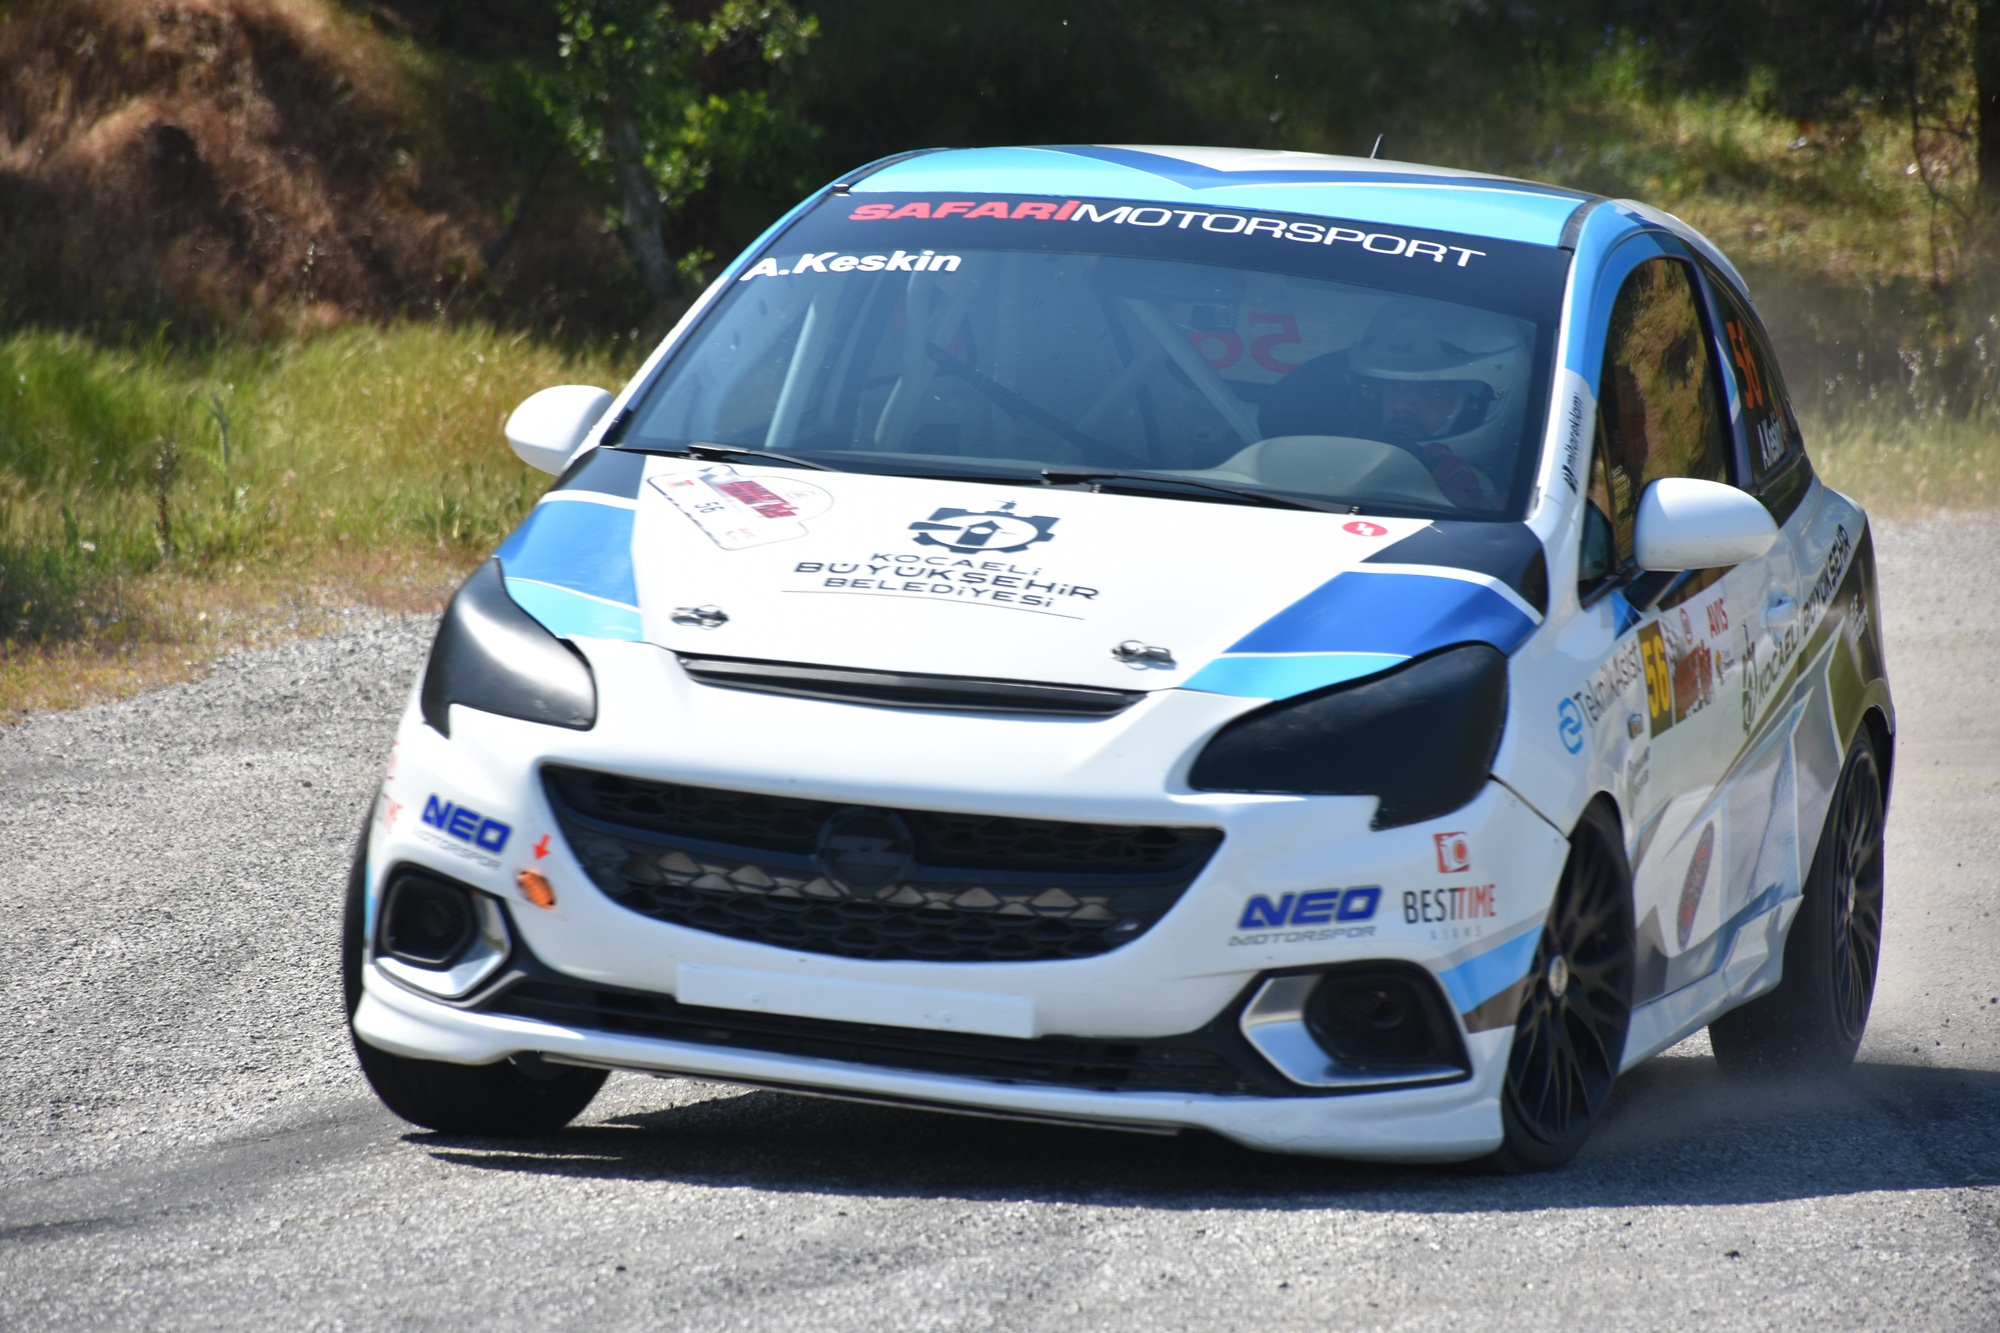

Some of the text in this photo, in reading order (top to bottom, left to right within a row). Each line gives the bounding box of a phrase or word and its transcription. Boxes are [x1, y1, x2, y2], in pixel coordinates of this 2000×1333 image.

[739, 250, 962, 281] A.Keskin
[1706, 597, 1729, 639] AVIS
[1640, 634, 1671, 719] 56
[421, 792, 513, 856] NEO
[1237, 884, 1383, 931] NEO
[1228, 925, 1377, 947] MOTORSPOR
